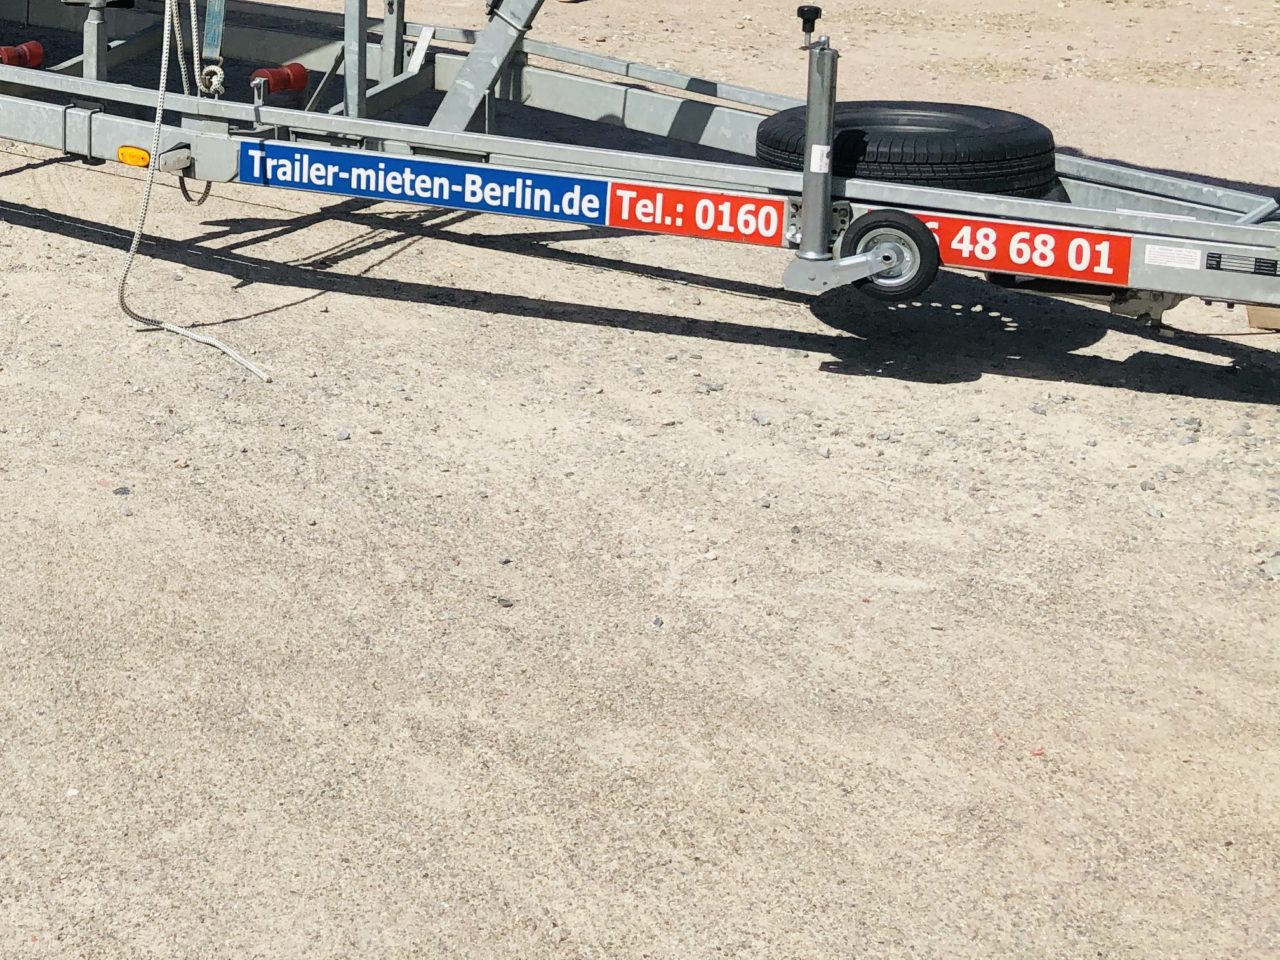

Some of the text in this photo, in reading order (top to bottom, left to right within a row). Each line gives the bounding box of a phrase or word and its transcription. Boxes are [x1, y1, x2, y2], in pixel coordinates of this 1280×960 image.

[248, 150, 600, 218] Trailer-mieten-Berlin.de
[615, 189, 778, 238] Tel.: 0160
[951, 225, 997, 261] 48
[1009, 231, 1055, 268] 68
[1068, 237, 1114, 275] 01
